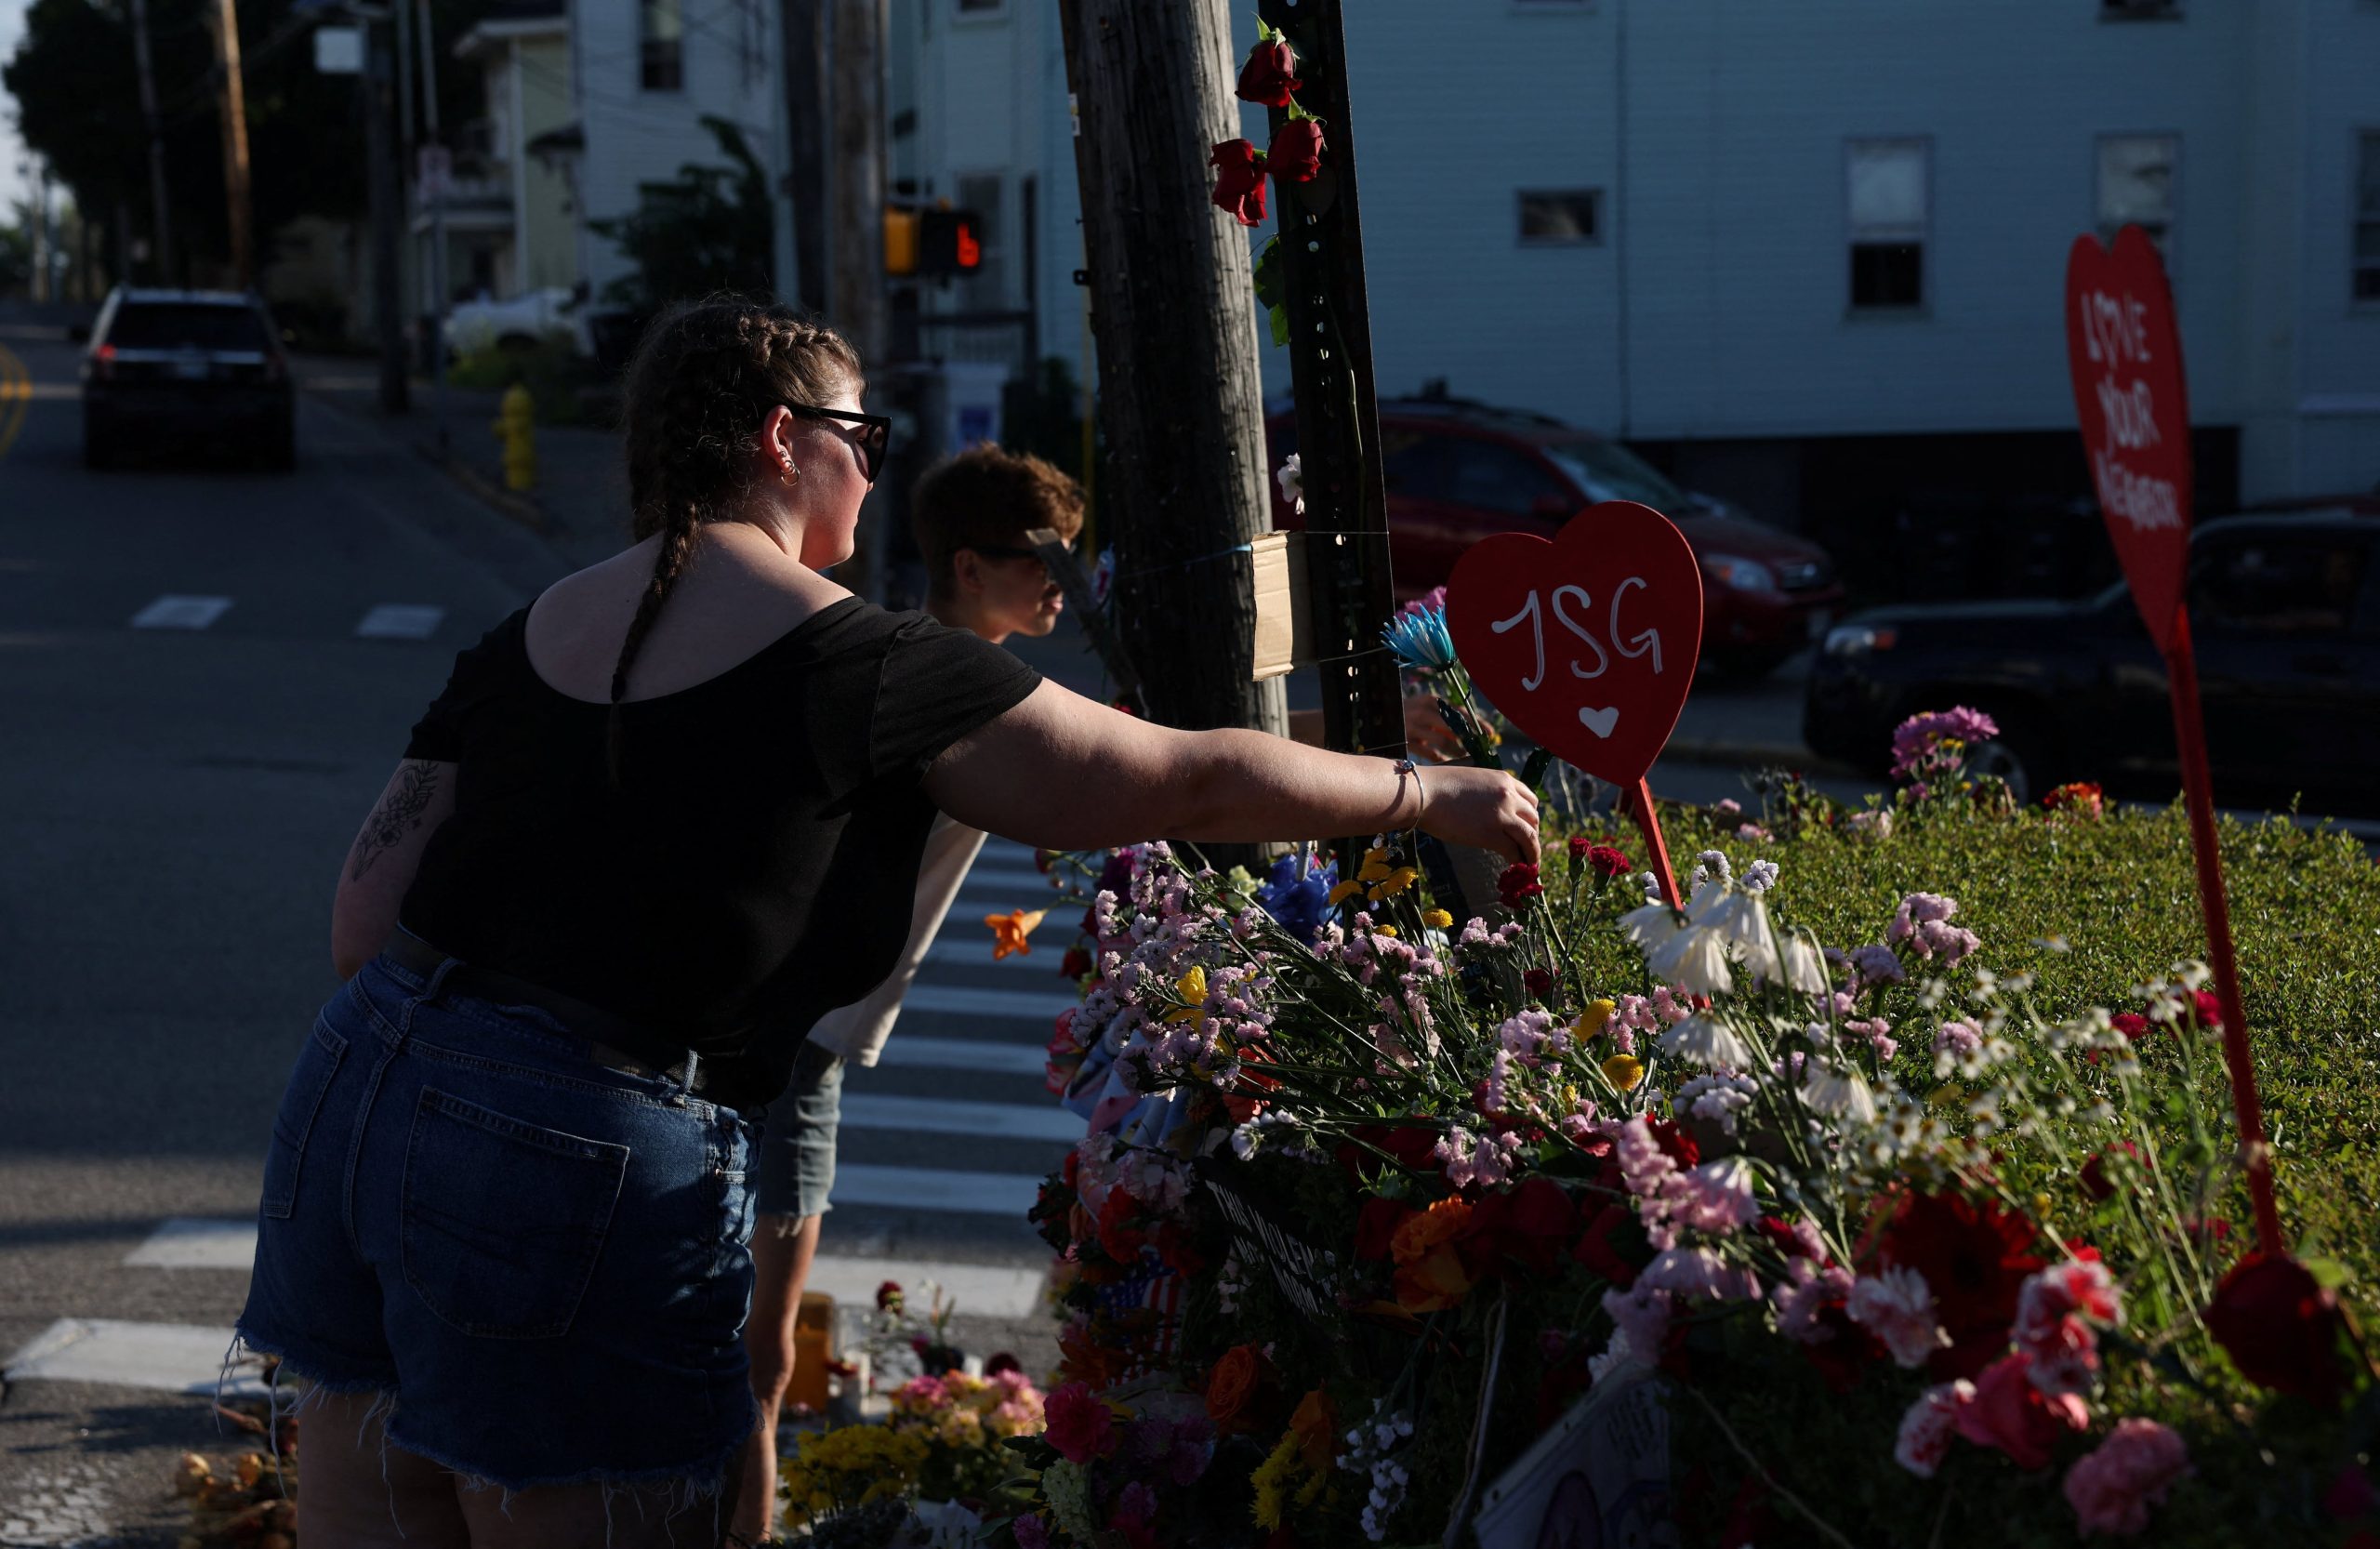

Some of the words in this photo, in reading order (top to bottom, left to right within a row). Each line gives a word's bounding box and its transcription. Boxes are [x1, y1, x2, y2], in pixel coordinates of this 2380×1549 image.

[2080, 289, 2152, 370] LOVE
[2096, 372, 2162, 457] YOUR
[1490, 576, 1664, 693] JSG
[1205, 1180, 1253, 1233] THIS
